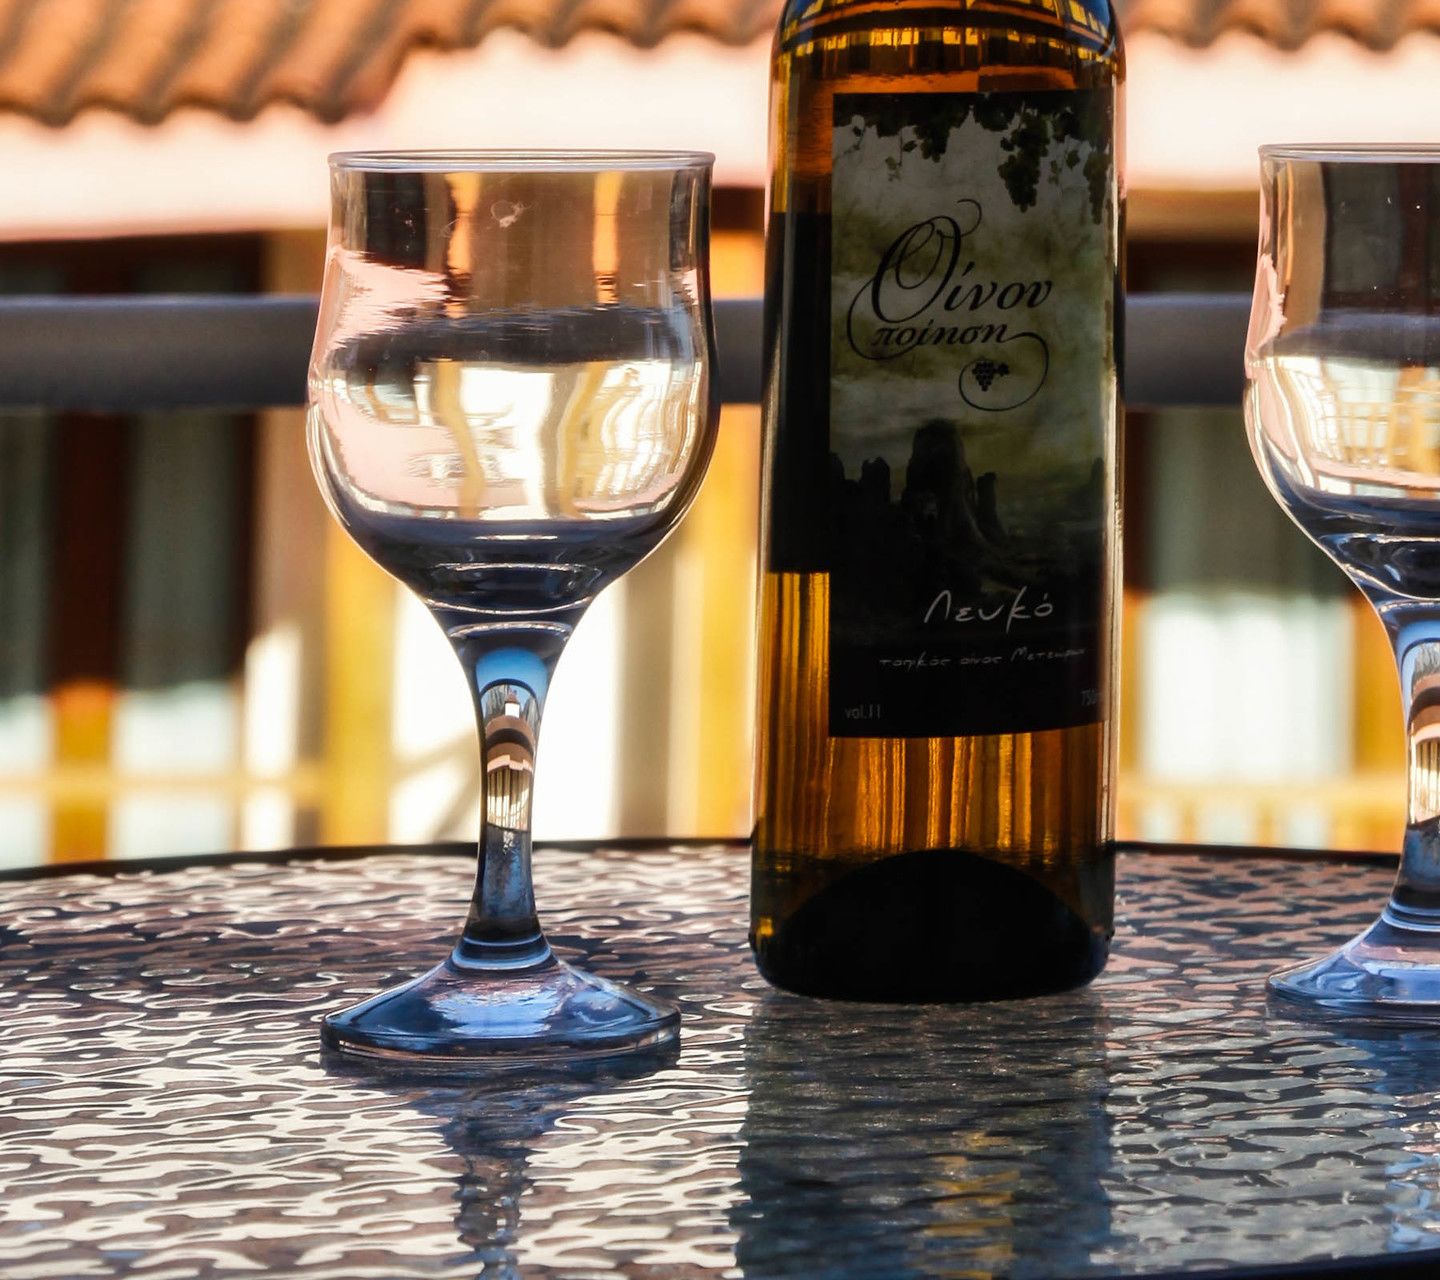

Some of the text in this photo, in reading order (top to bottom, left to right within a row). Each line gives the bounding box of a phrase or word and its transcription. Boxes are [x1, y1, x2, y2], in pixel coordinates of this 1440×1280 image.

[847, 199, 1052, 325] Οίνου
[870, 319, 1012, 348] ποίηση
[924, 586, 1053, 634] Λευκό
